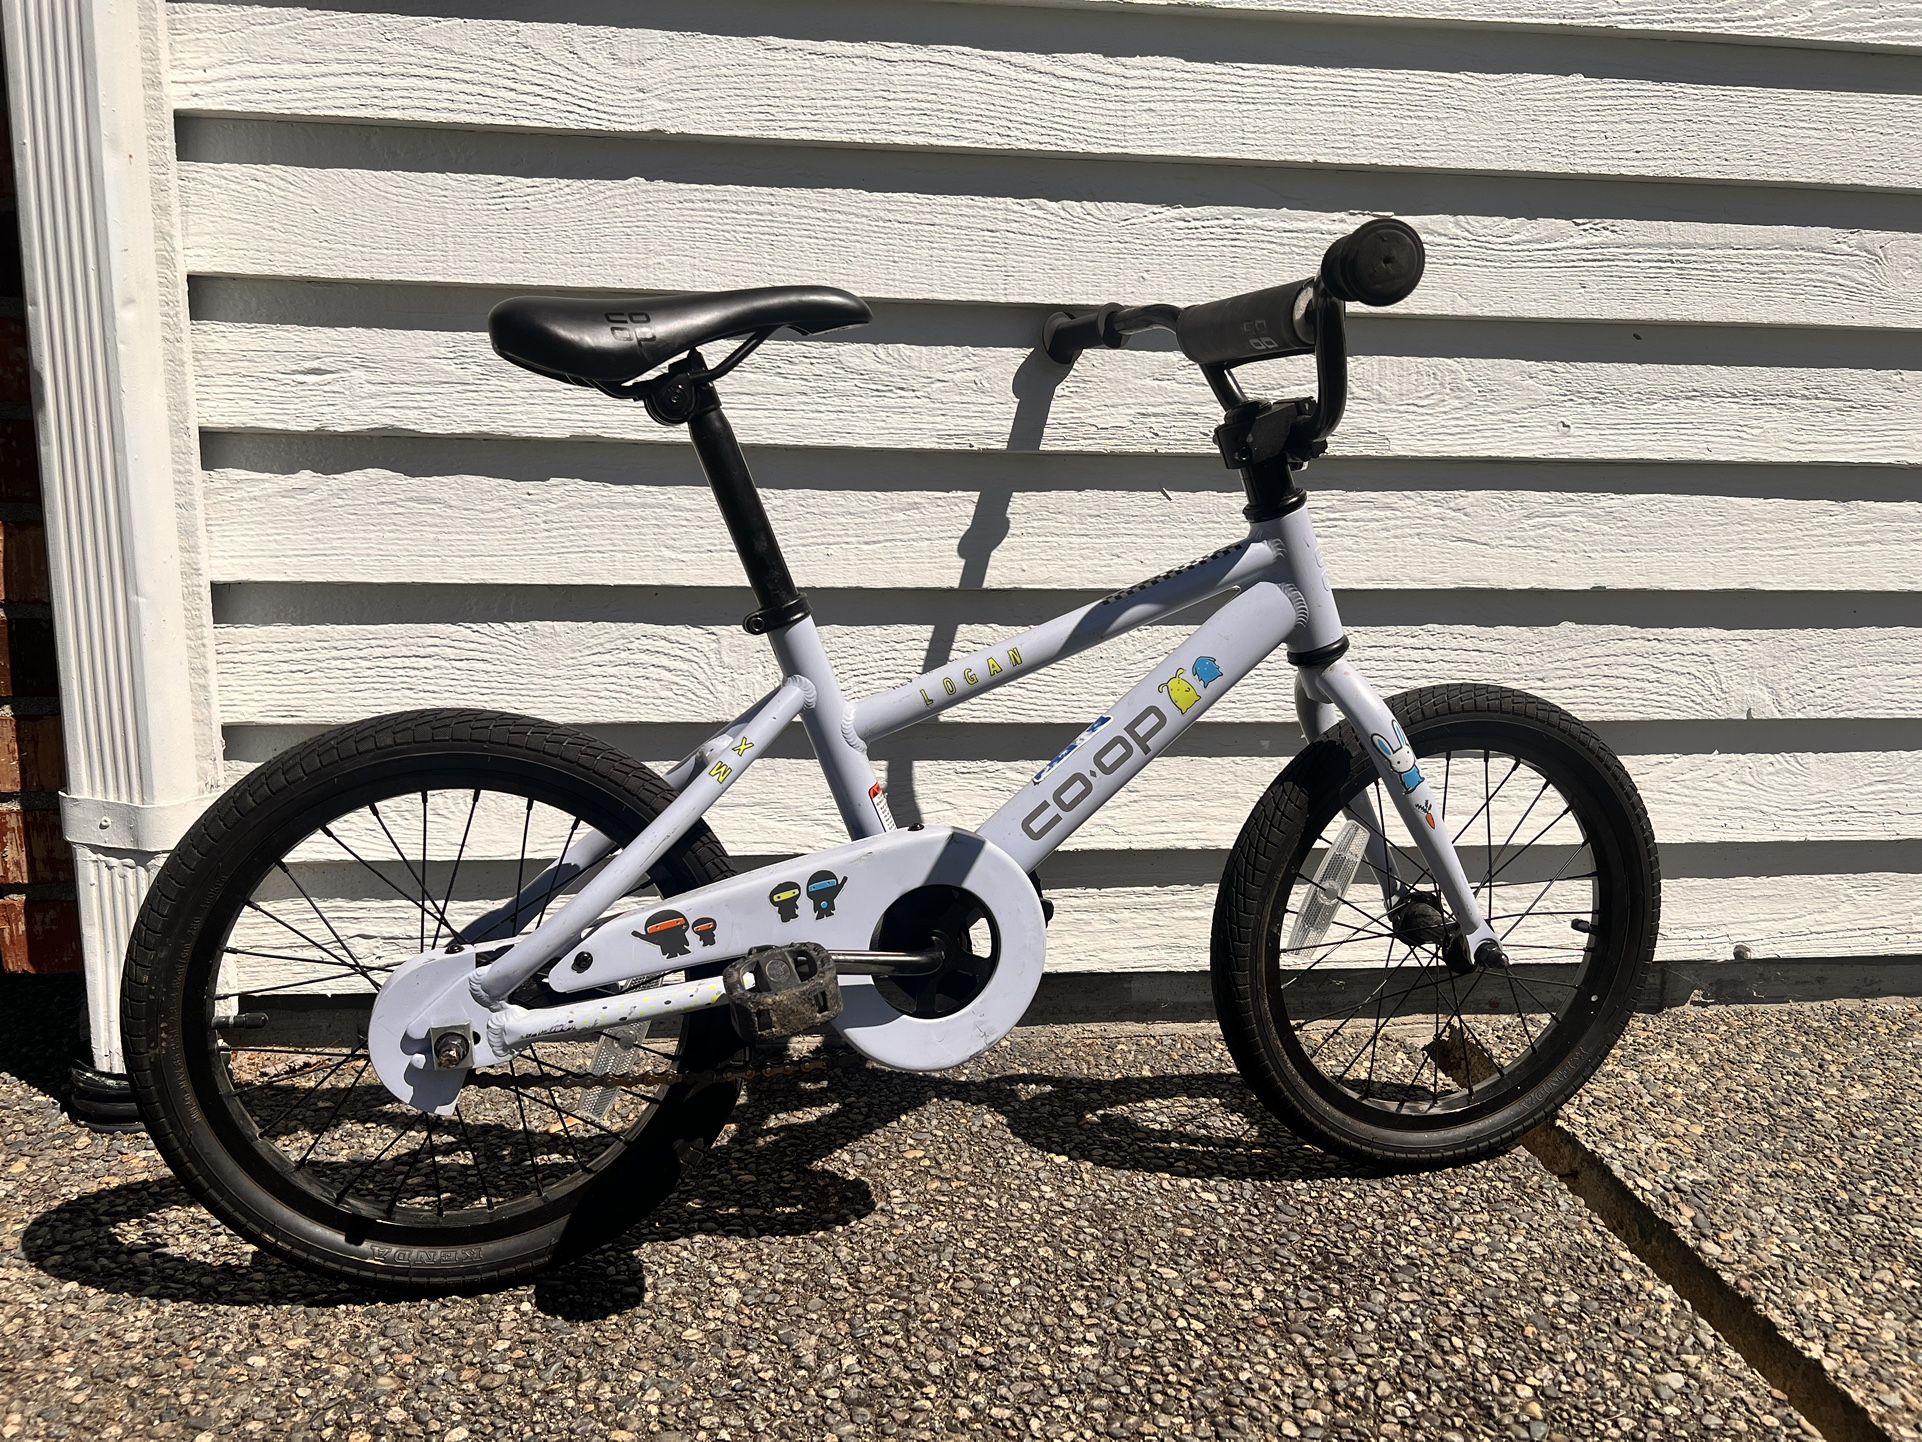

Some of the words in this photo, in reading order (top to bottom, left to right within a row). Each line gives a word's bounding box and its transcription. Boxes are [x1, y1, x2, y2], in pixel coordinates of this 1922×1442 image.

[604, 312, 651, 324] CO
[920, 647, 1023, 707] LOGAN
[370, 1246, 483, 1265] KENDA
